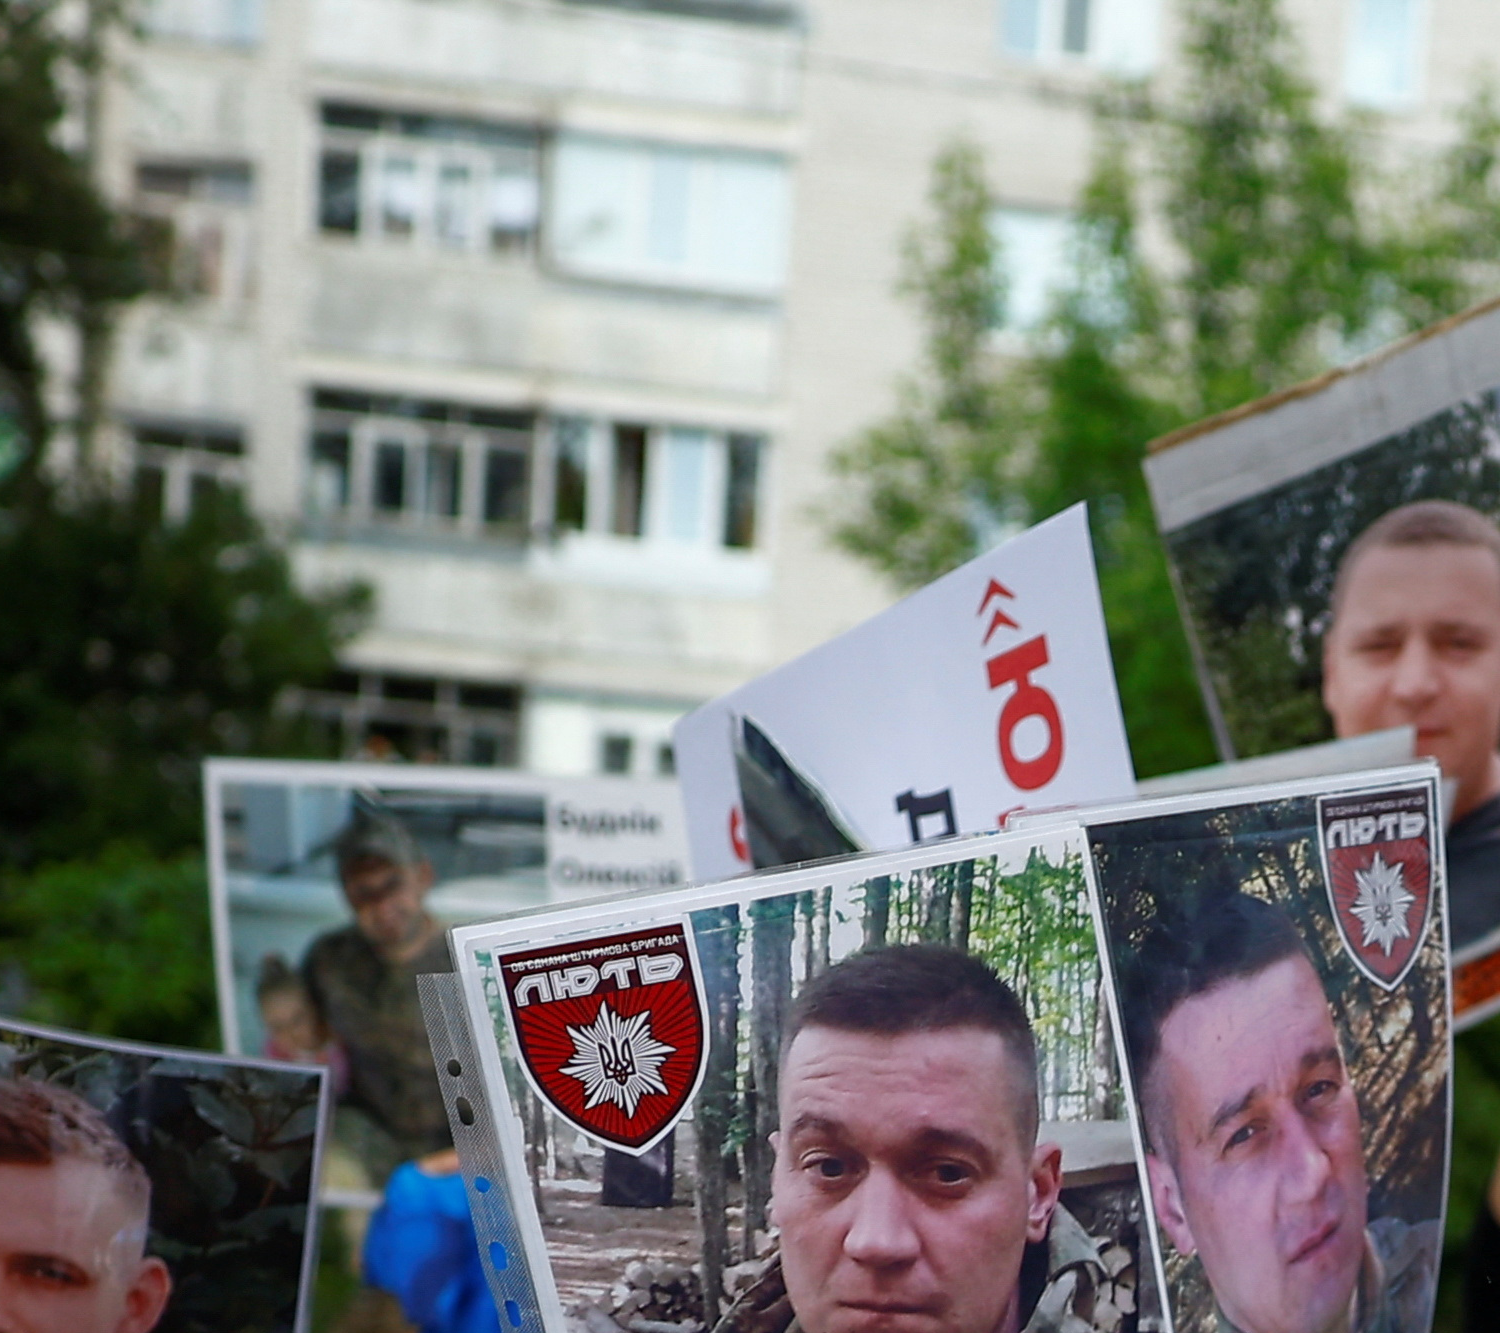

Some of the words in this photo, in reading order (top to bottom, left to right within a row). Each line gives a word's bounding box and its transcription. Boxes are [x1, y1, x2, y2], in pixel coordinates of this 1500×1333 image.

[1325, 811, 1427, 849] ЛЮТЬ
[632, 934, 680, 952] БРИГАДА
[513, 952, 686, 1008] ЛЮТЬ
